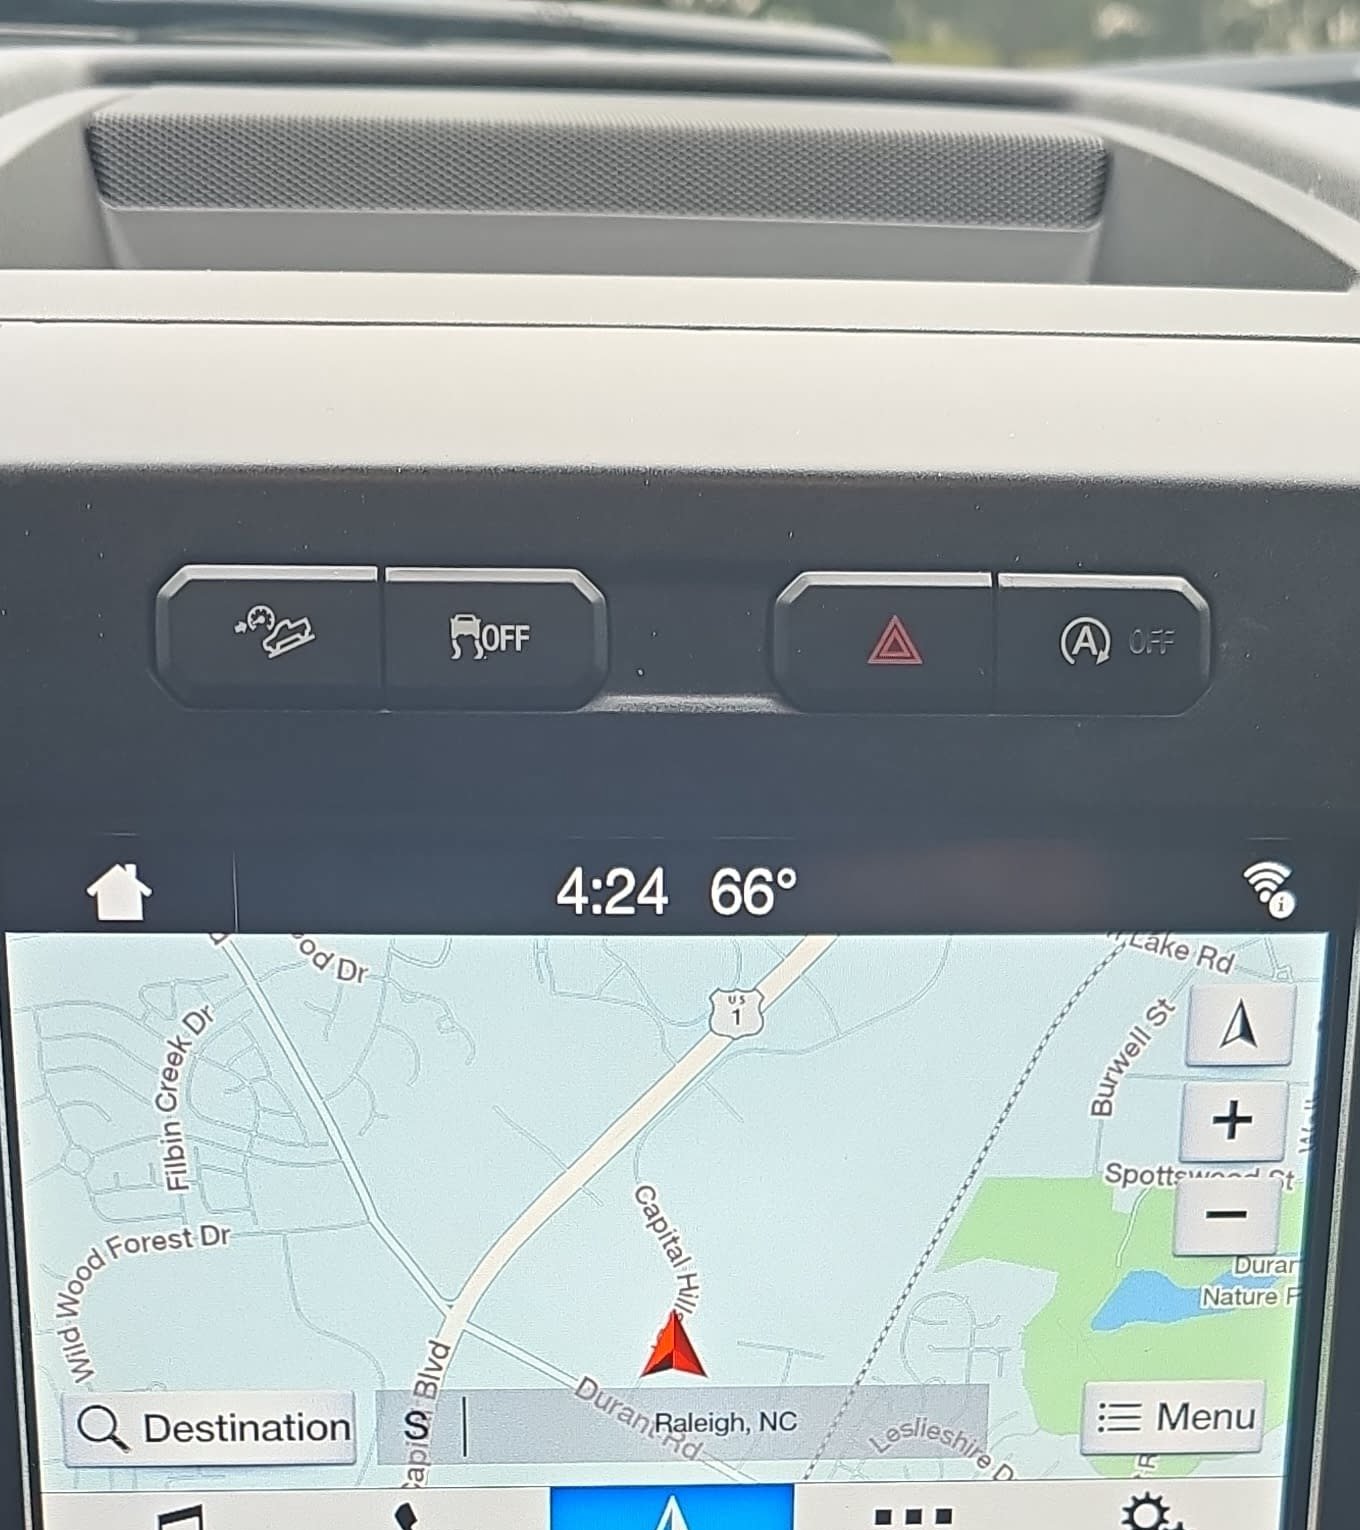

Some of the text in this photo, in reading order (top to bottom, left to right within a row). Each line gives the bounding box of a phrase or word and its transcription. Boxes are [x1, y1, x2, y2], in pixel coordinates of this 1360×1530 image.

[481, 624, 530, 652] OFF
[1129, 628, 1176, 656] OFF
[556, 866, 669, 916] 4:24
[710, 867, 797, 916] 66°
[336, 957, 369, 984] Dr
[1196, 945, 1236, 975] Rd
[731, 1008, 741, 1026] 1
[1091, 998, 1177, 1117] Burwell St
[155, 1004, 215, 1191] Filbin Creek Dr
[634, 1185, 691, 1268] Capital
[55, 1224, 231, 1384] Wild Wood Forest Dr
[1203, 1287, 1278, 1307] Nature
[413, 1338, 451, 1400] Blvd
[144, 1413, 352, 1445] Destination
[404, 1410, 430, 1441] S
[654, 1411, 798, 1437] Raleigh, NC
[1156, 1401, 1256, 1433] Menu
